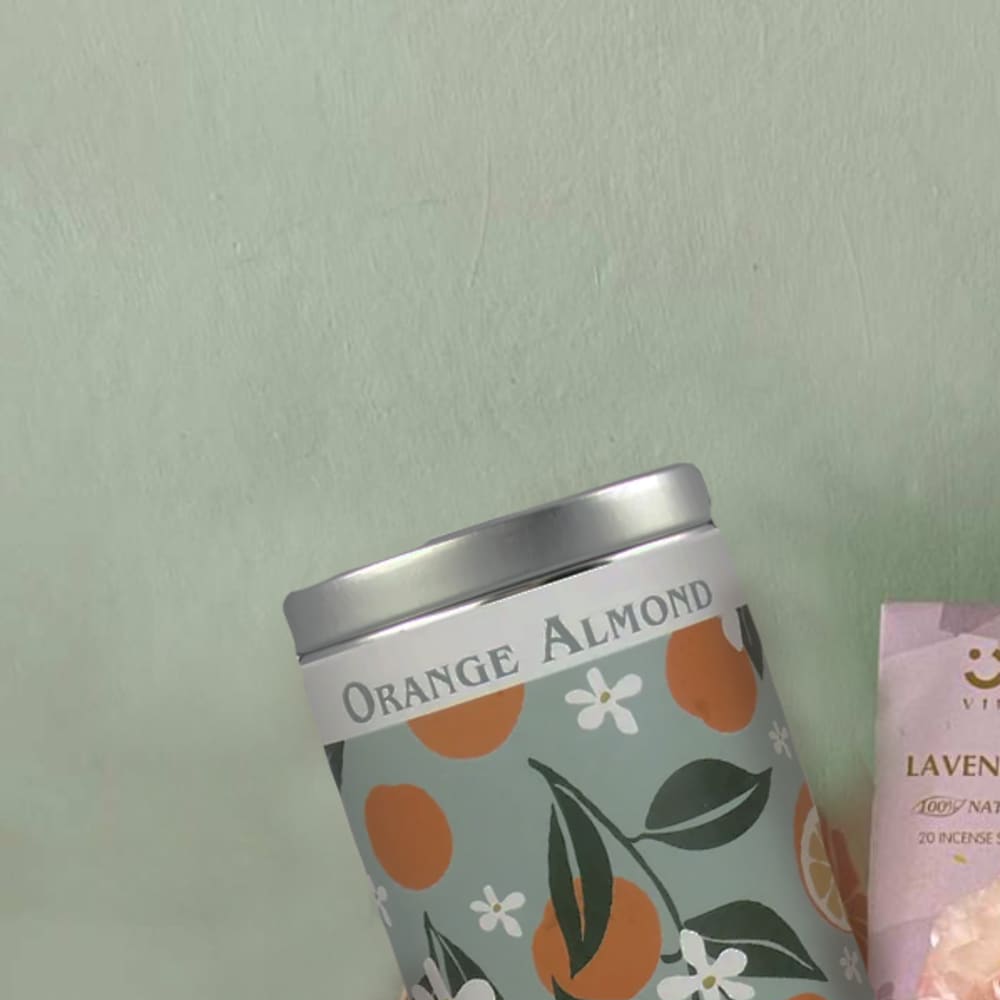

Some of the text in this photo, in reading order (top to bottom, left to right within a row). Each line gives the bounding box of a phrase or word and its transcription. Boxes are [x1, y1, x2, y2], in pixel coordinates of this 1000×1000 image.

[342, 578, 714, 724] ORANGE ALMOND
[918, 831, 936, 845] 20
[938, 831, 993, 845] INCENSE
